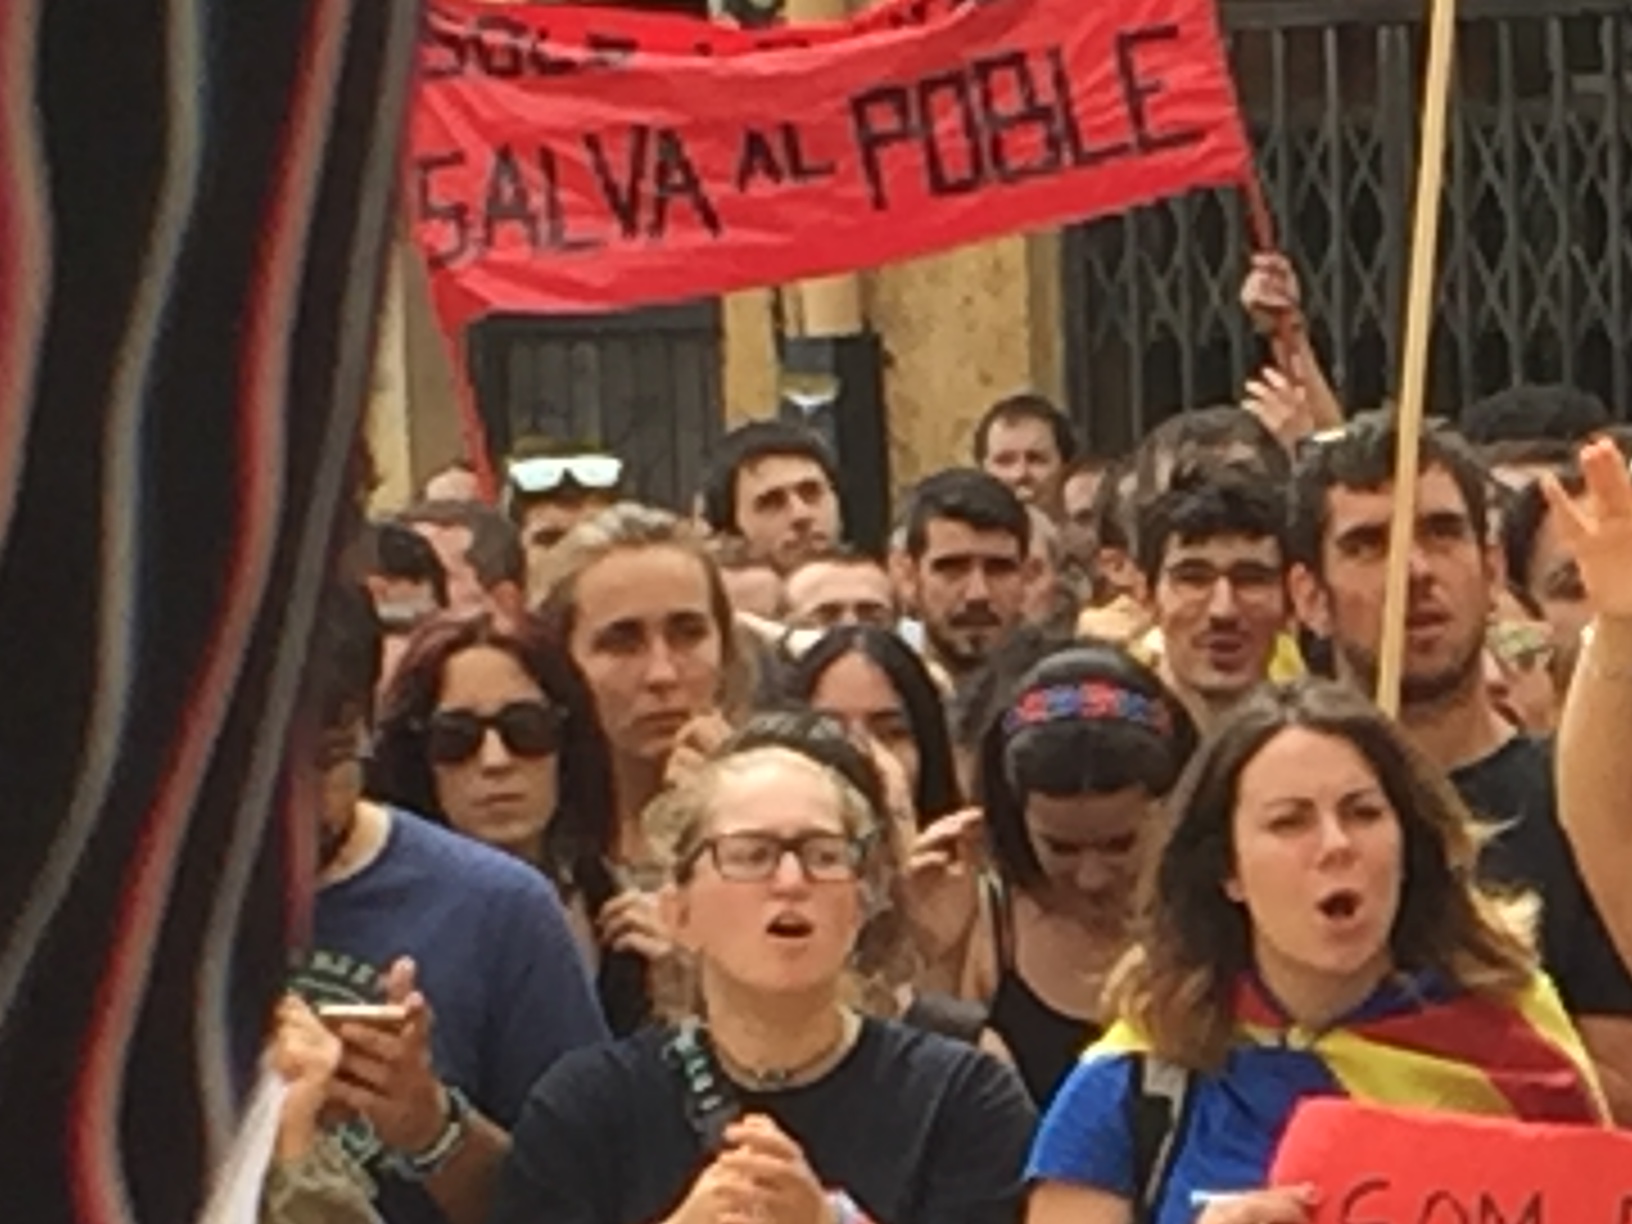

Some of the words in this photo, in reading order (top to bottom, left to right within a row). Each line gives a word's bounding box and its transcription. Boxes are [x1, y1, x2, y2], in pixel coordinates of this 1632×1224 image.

[413, 124, 720, 267] SALVA
[736, 122, 836, 194] AL
[851, 24, 1201, 210] POBLE
